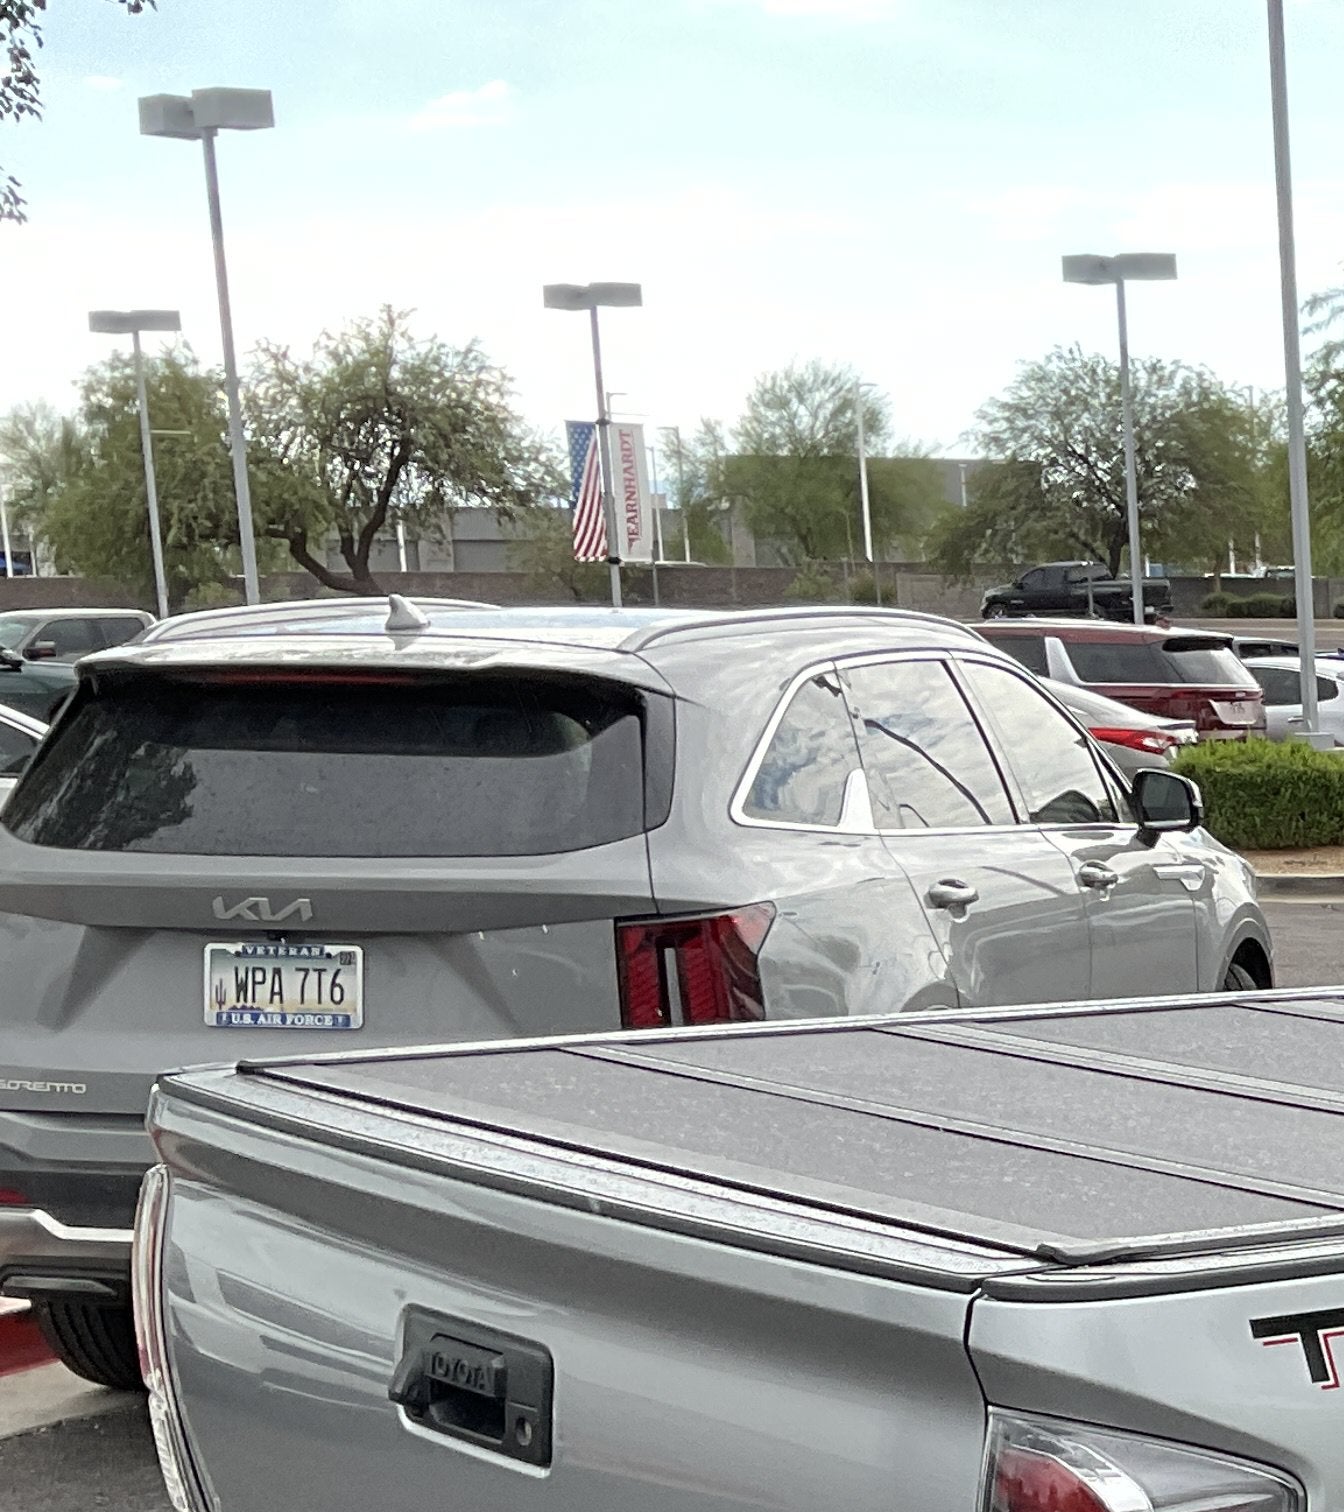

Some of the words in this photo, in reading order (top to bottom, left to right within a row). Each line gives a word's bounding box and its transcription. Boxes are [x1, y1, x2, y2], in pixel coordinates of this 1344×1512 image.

[213, 896, 313, 922] KIA
[245, 945, 321, 957] VETERAN
[234, 966, 284, 1005] WPA
[295, 968, 345, 1006] 7T6
[231, 1014, 255, 1025] U.S.
[257, 1014, 282, 1025] AIR
[285, 1014, 334, 1026] FORCE
